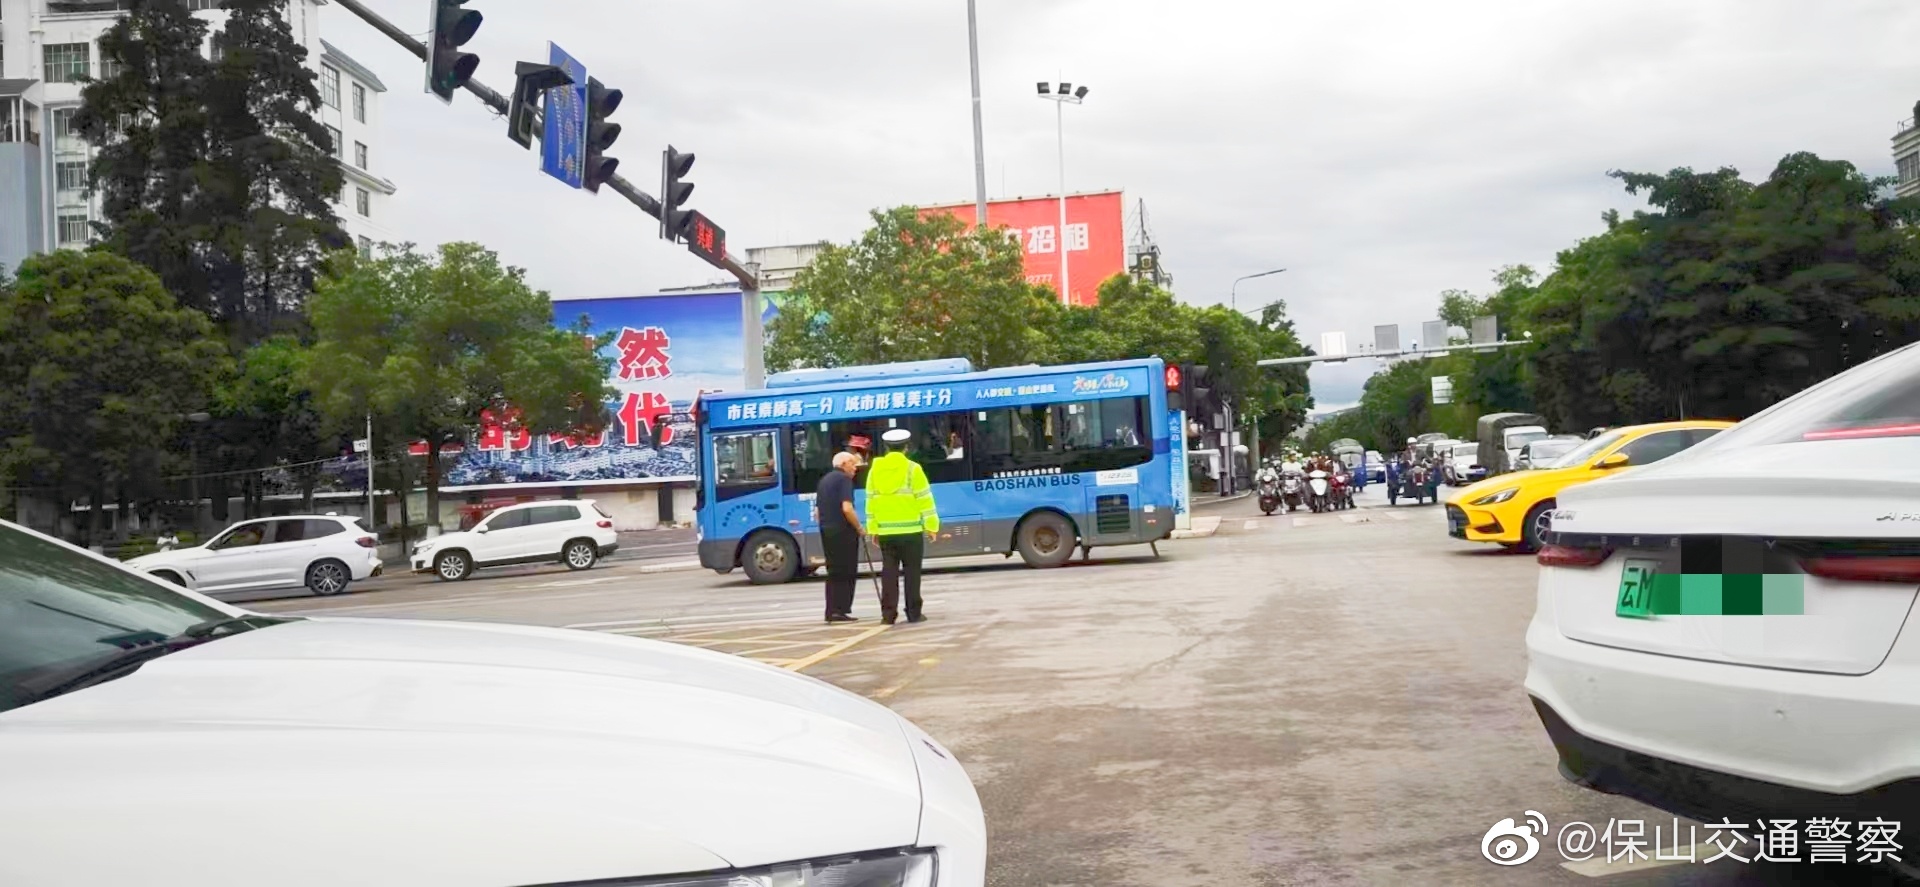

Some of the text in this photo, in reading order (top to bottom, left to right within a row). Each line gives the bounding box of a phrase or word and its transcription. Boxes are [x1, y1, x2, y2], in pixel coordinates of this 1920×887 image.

[727, 397, 833, 421] 市民素质高一分
[845, 388, 952, 412] 城市形象美十分
[974, 475, 1047, 492] BAOSHAN
[1050, 474, 1081, 487] BUS
